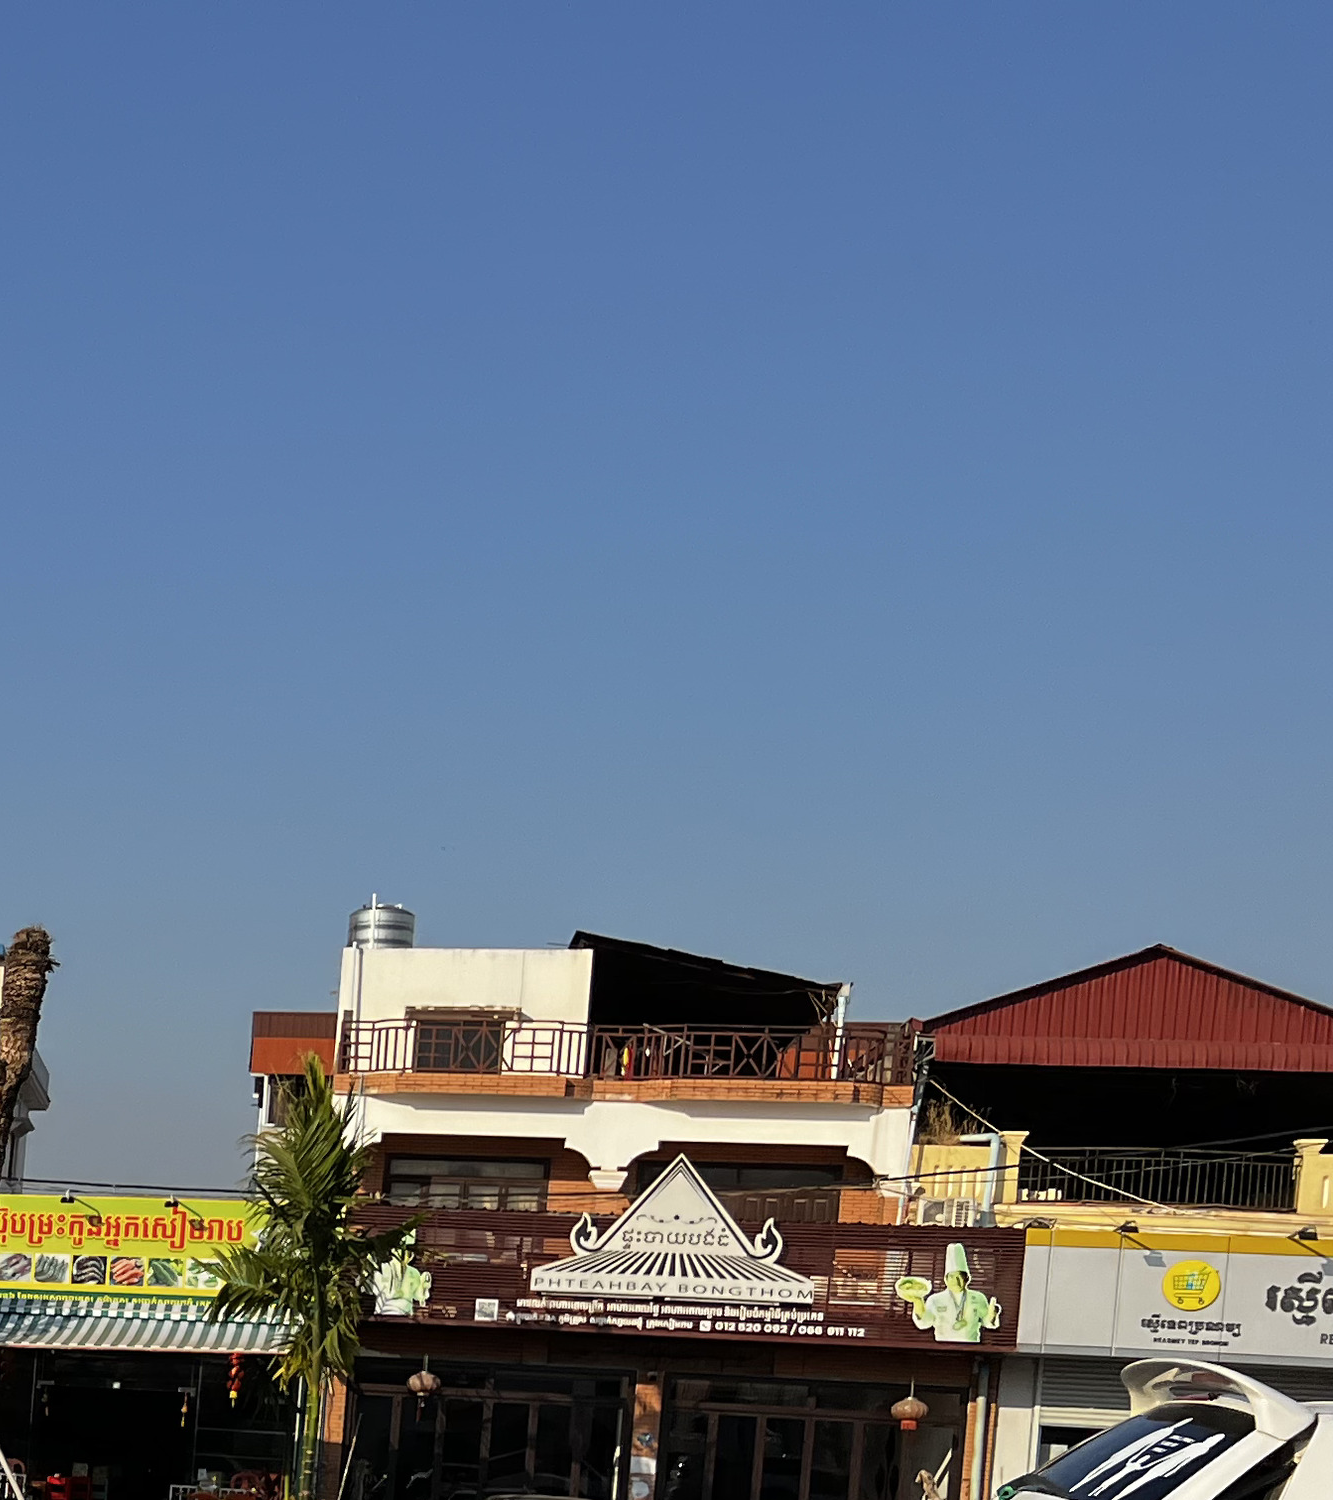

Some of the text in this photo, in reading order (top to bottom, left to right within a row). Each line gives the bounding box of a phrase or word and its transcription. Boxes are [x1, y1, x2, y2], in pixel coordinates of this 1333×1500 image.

[534, 1277, 814, 1300] PHTEAHBAY BONGTHOM
[714, 1321, 736, 1331] 012
